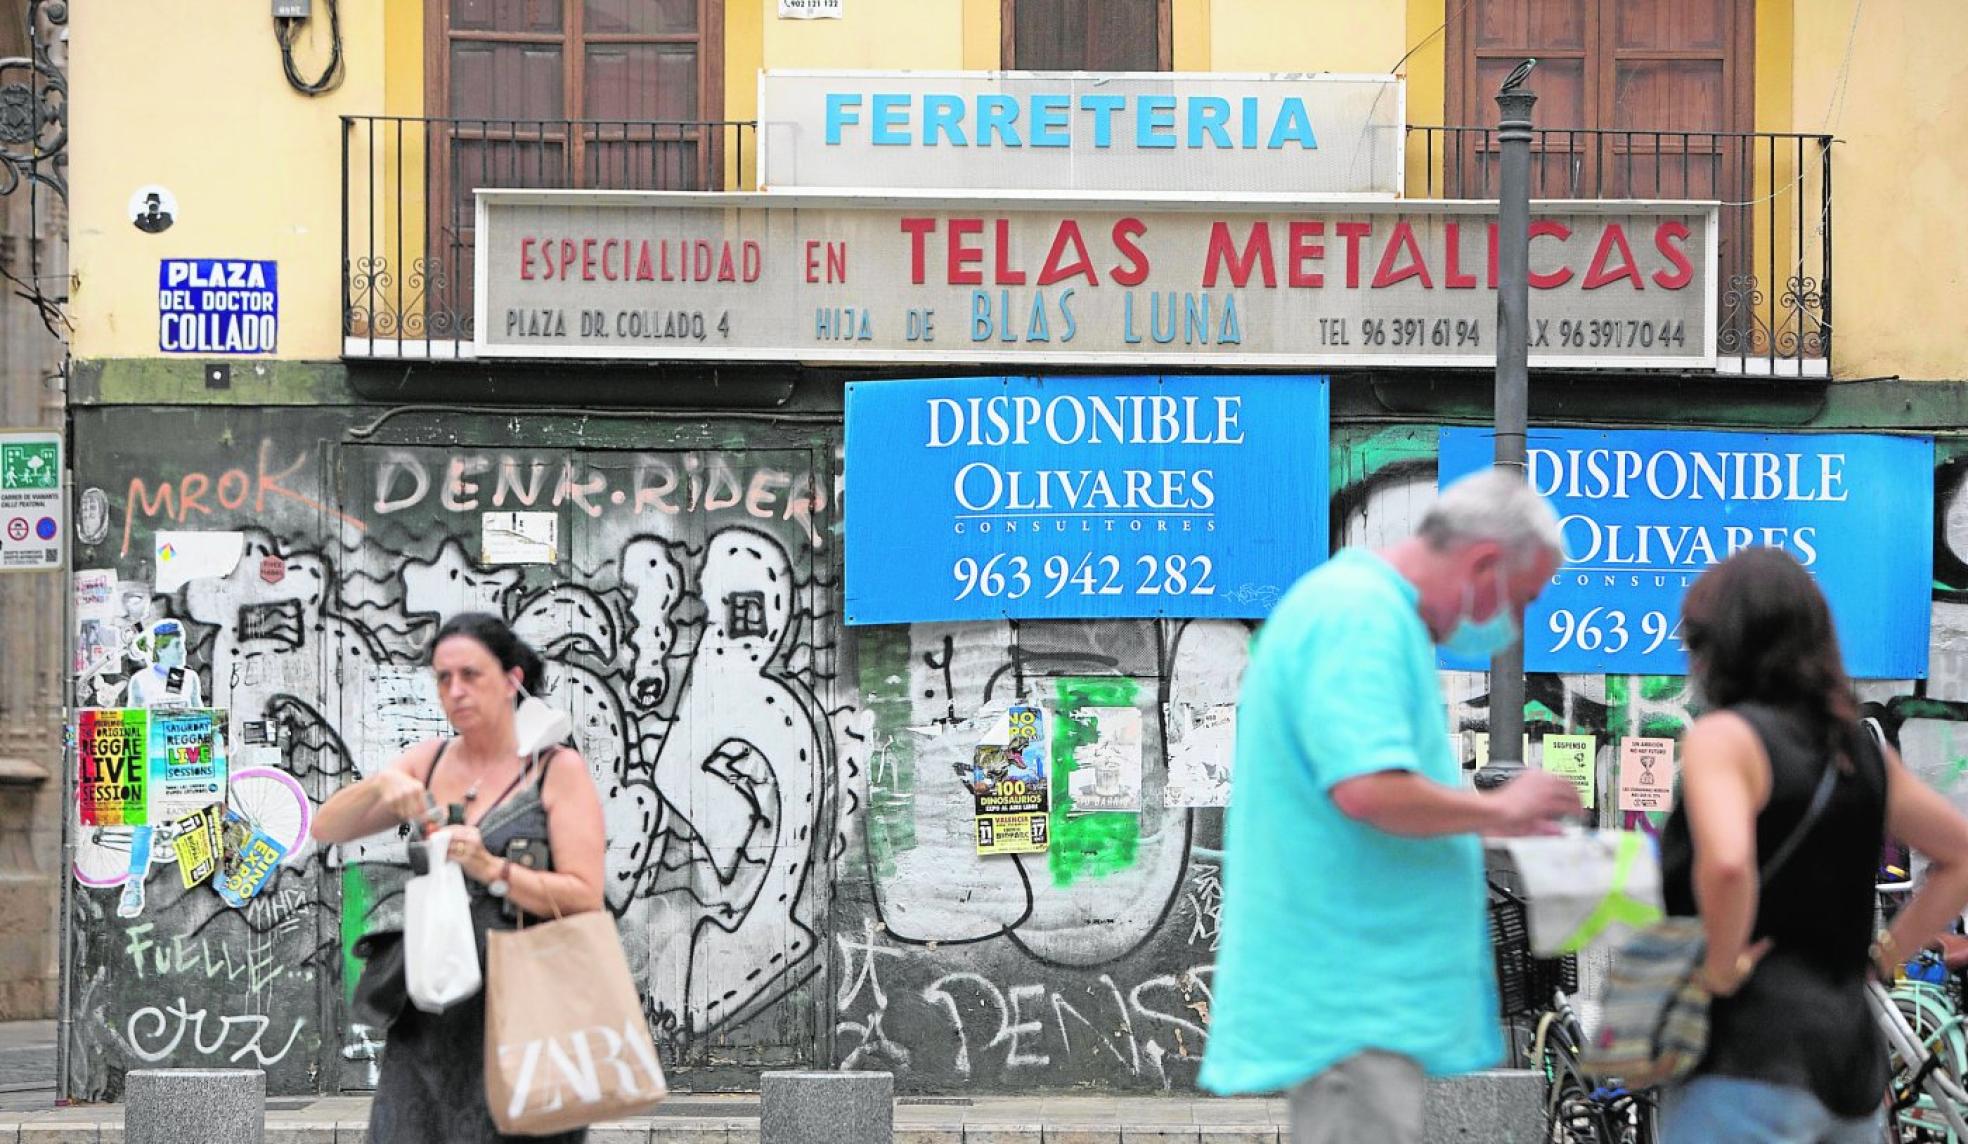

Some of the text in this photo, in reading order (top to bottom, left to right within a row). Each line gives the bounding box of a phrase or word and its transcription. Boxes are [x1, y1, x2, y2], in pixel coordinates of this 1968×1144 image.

[825, 93, 1319, 151] FERRETERIA
[520, 217, 1694, 291] ESPECIALIDAD EN TELAS METALICAS
[168, 261, 265, 289] PLAZA
[160, 290, 275, 312] DEL DOCTOR
[161, 312, 275, 351] COLLADO
[506, 308, 566, 337] PLAZA
[716, 311, 729, 338] 4
[815, 309, 873, 340] HIJA
[906, 309, 935, 341] DE
[972, 289, 1076, 342] BLAS
[1124, 292, 1241, 346] LUNA
[1319, 318, 1349, 346] TEL
[926, 395, 1246, 448] DISPONIBLE
[955, 463, 1215, 511] OLIVARES
[1526, 449, 1848, 501] DISPONIBLE
[955, 519, 1216, 534] CONSULTORES
[954, 553, 1032, 601] 963
[1043, 552, 1121, 597] 942
[1136, 554, 1216, 597] 282
[1549, 607, 1629, 654] 963
[96, 728, 141, 737] ORIGINAL
[166, 722, 210, 733] SATURDAY
[167, 734, 213, 746] REGGAE
[82, 739, 142, 756] REGGAE
[168, 745, 212, 766] LIVE
[83, 756, 142, 784] LIVE
[83, 785, 142, 801] SESSION
[980, 795, 1042, 806] DINOSAURIOS
[997, 780, 1026, 796] 100
[227, 839, 270, 891] EXPO
[240, 846, 280, 899] DINO
[500, 1018, 667, 1121] ZARA
